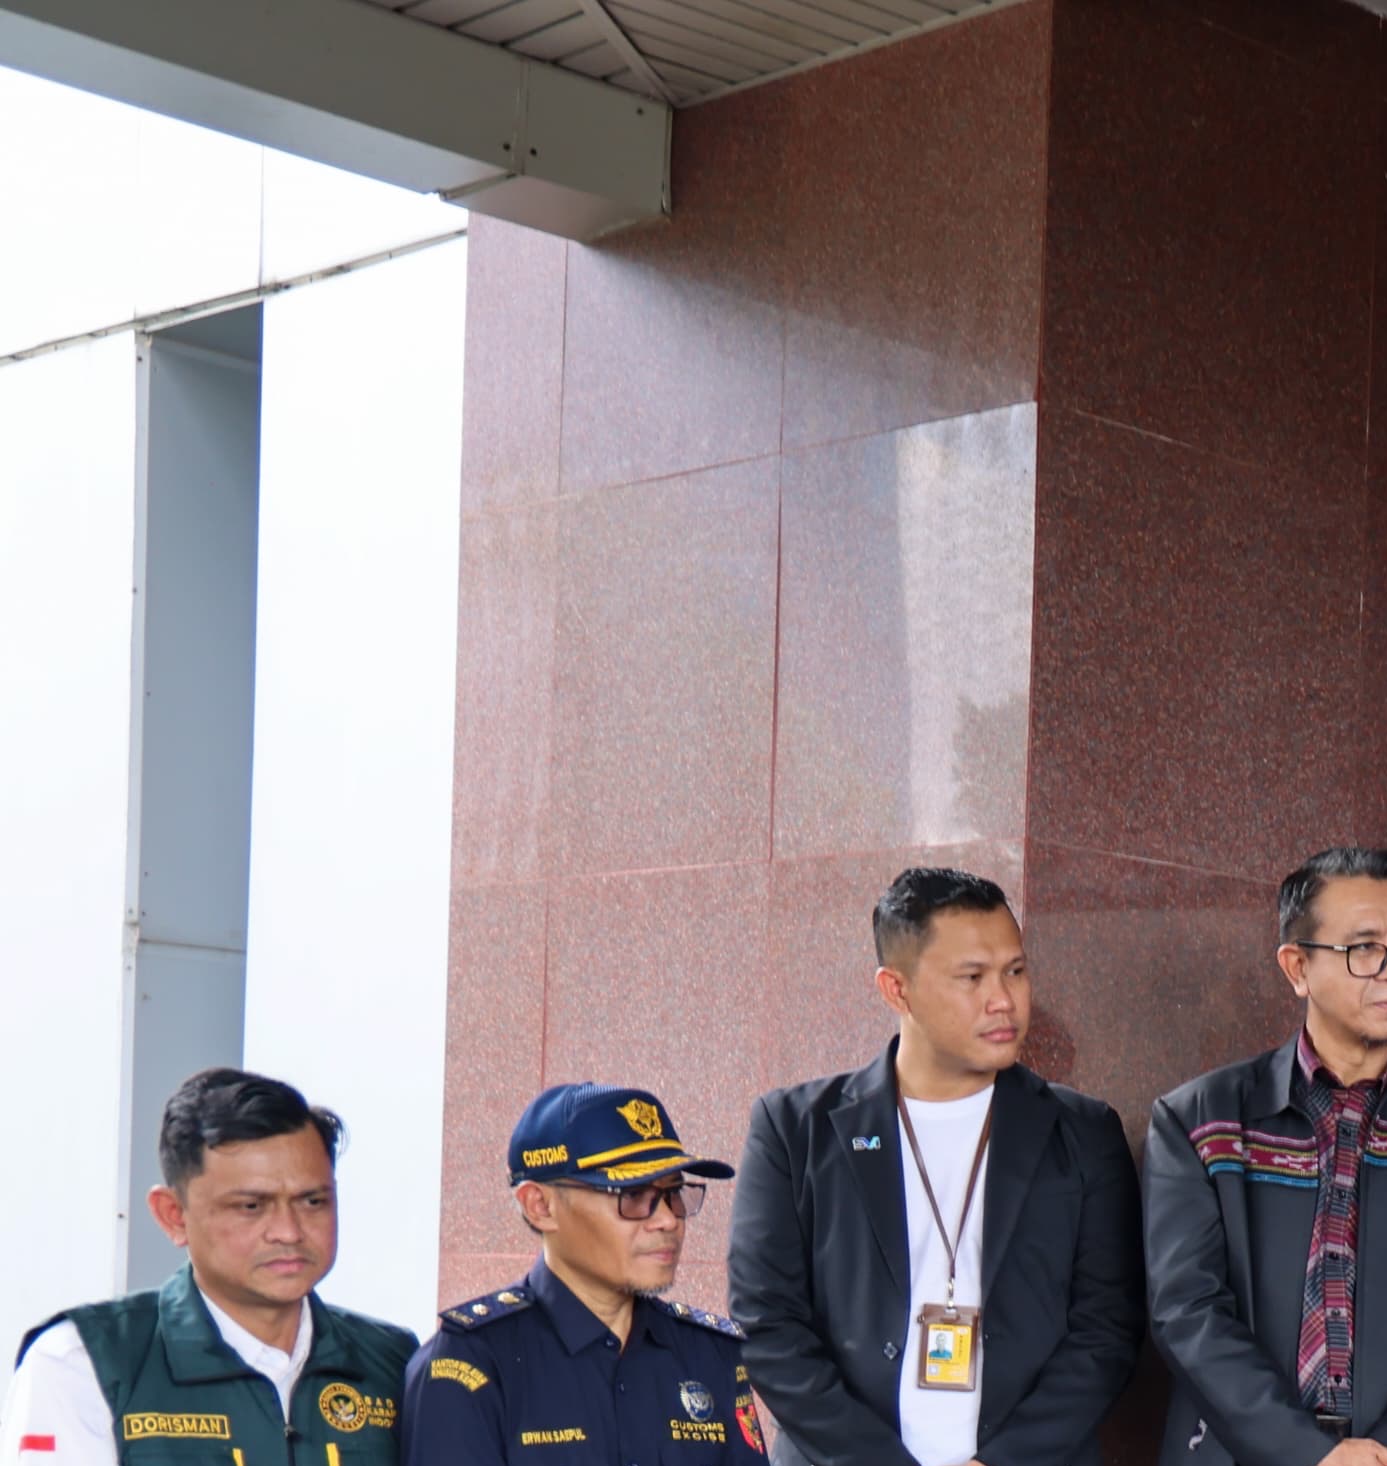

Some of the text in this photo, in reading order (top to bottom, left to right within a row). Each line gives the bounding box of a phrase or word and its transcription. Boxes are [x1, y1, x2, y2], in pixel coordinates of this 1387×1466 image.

[523, 1144, 568, 1167] CUSTOMS
[130, 1416, 220, 1433] DORISMAN
[670, 1419, 725, 1433] CUSTOMS
